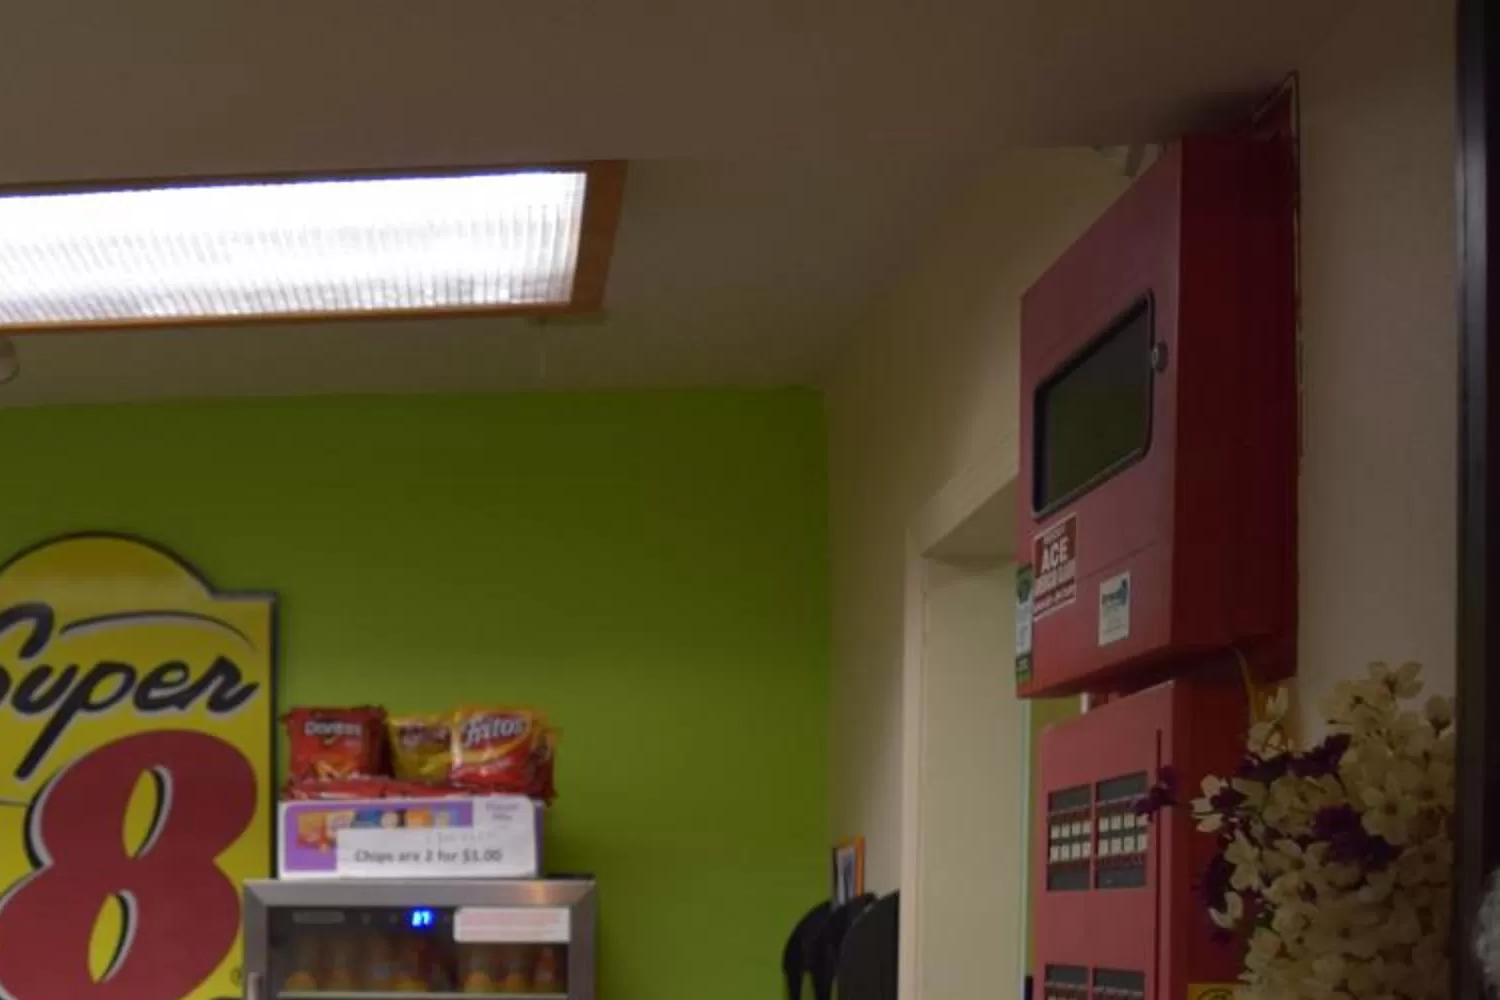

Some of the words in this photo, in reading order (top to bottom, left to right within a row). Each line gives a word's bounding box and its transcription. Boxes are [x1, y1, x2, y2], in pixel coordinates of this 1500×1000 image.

[354, 848, 395, 865] Chips
[398, 850, 421, 864] are
[436, 847, 458, 863] for
[462, 847, 503, 864] $1.00
